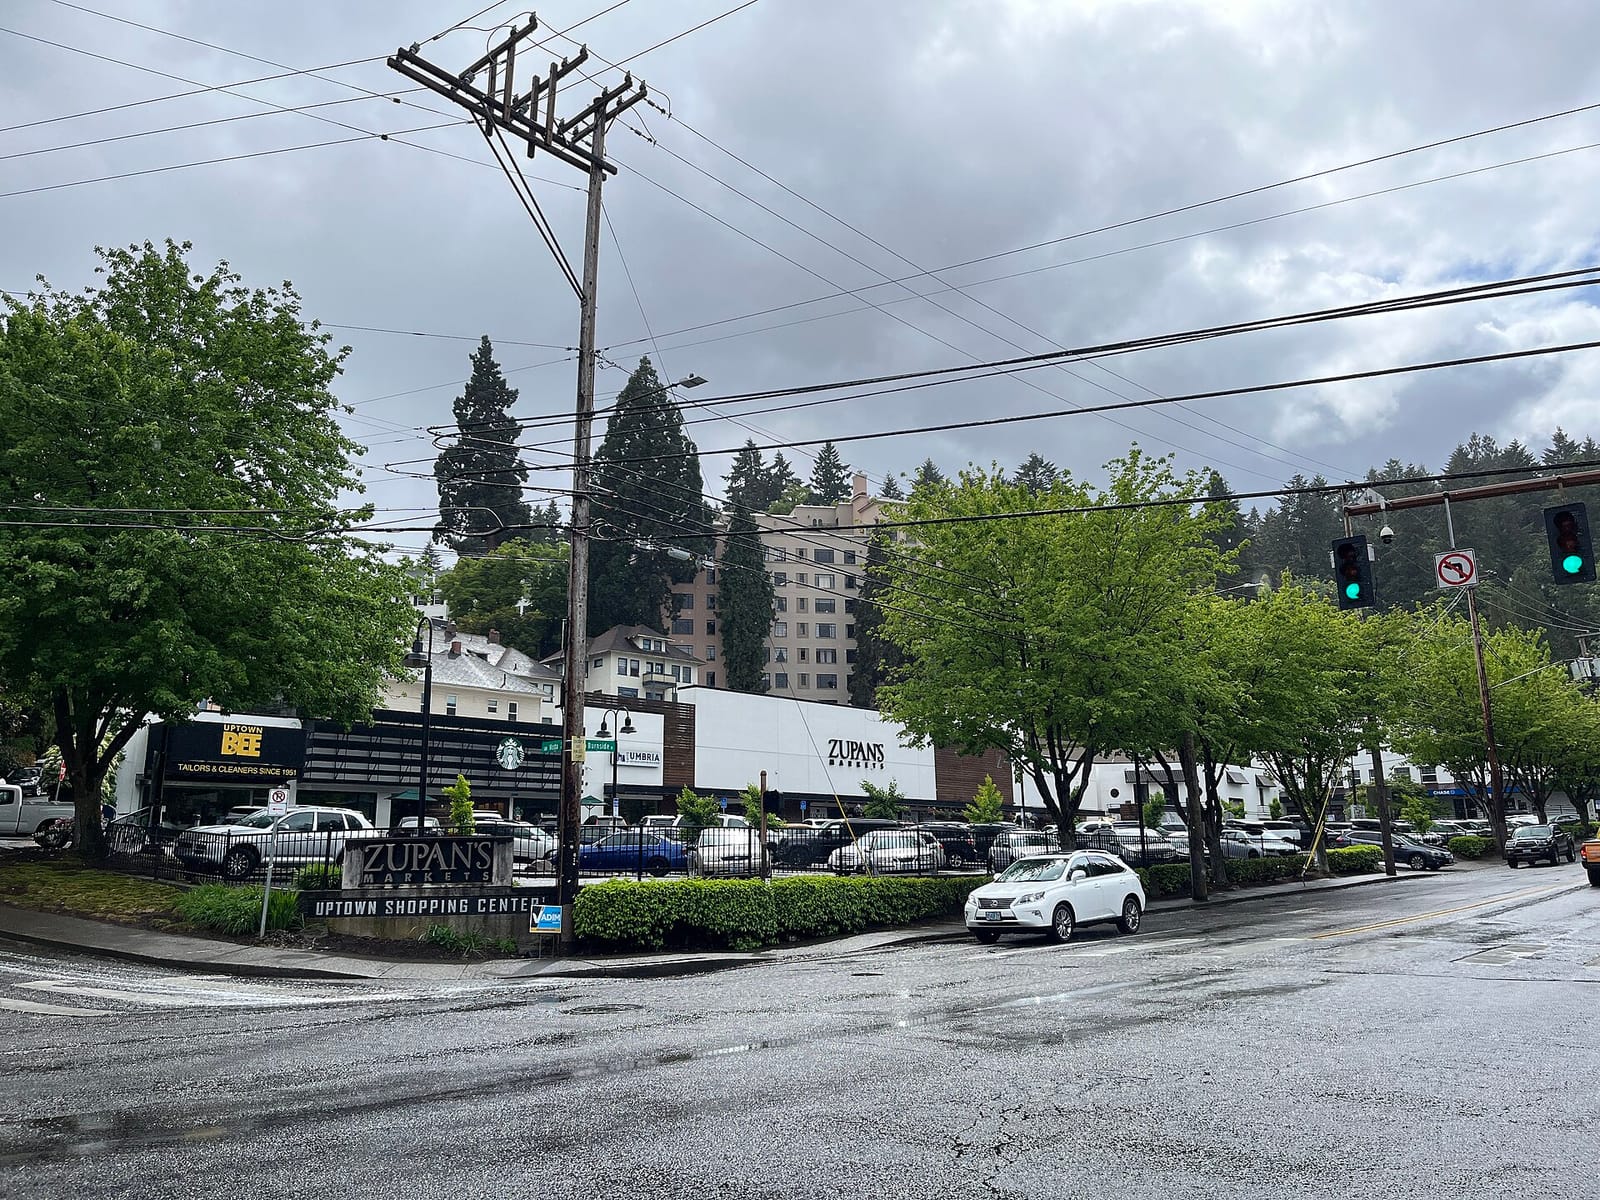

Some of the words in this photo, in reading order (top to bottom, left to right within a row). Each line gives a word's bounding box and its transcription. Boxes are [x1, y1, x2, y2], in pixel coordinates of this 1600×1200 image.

[223, 724, 263, 734] UPTOWN
[221, 731, 262, 757] BEE
[587, 742, 610, 750] Burnside
[630, 752, 660, 761] UMBRIA
[178, 763, 211, 772] TAILORS
[212, 765, 217, 773] &
[218, 766, 258, 775] CLEANERS
[259, 767, 281, 776] SINCE
[363, 841, 491, 872] ZUPAN'S
[363, 871, 490, 883] MARKETS
[316, 901, 376, 915] UPTOWN
[385, 899, 468, 914] SHOPPING
